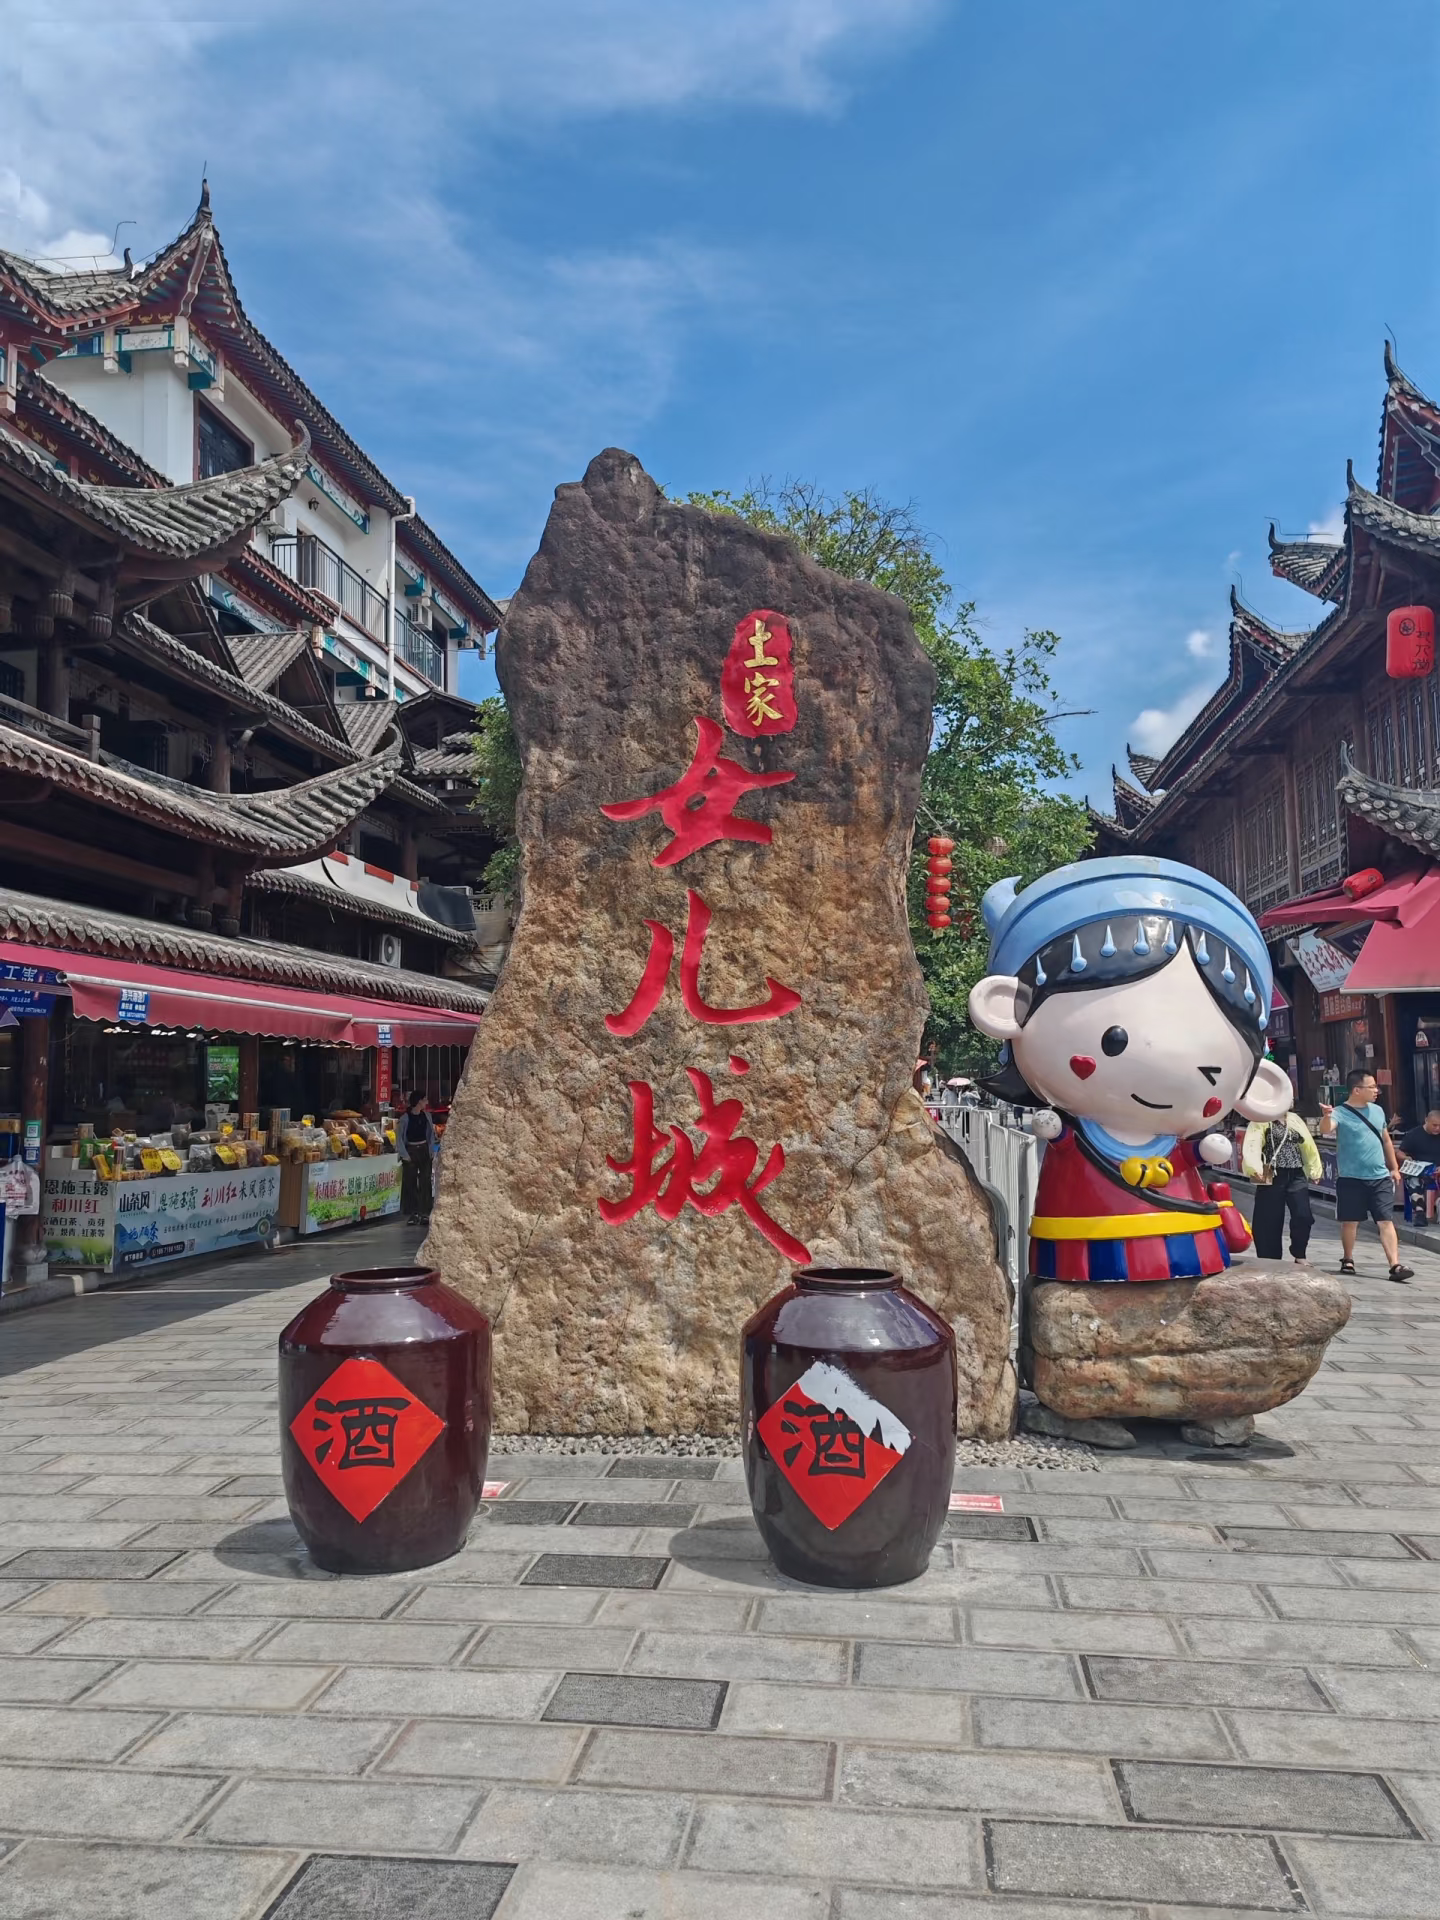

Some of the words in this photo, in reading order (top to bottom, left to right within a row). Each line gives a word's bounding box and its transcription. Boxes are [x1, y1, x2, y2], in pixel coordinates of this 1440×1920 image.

[743, 618, 784, 727] 土家
[597, 715, 813, 1264] 女儿城
[44, 1179, 109, 1196] 恩施玉露
[51, 1198, 101, 1214] 利川红
[119, 1190, 150, 1213] 山茶风
[201, 1181, 238, 1208] 利川红
[314, 1397, 412, 1470] 酒
[782, 1399, 868, 1479] 酒
